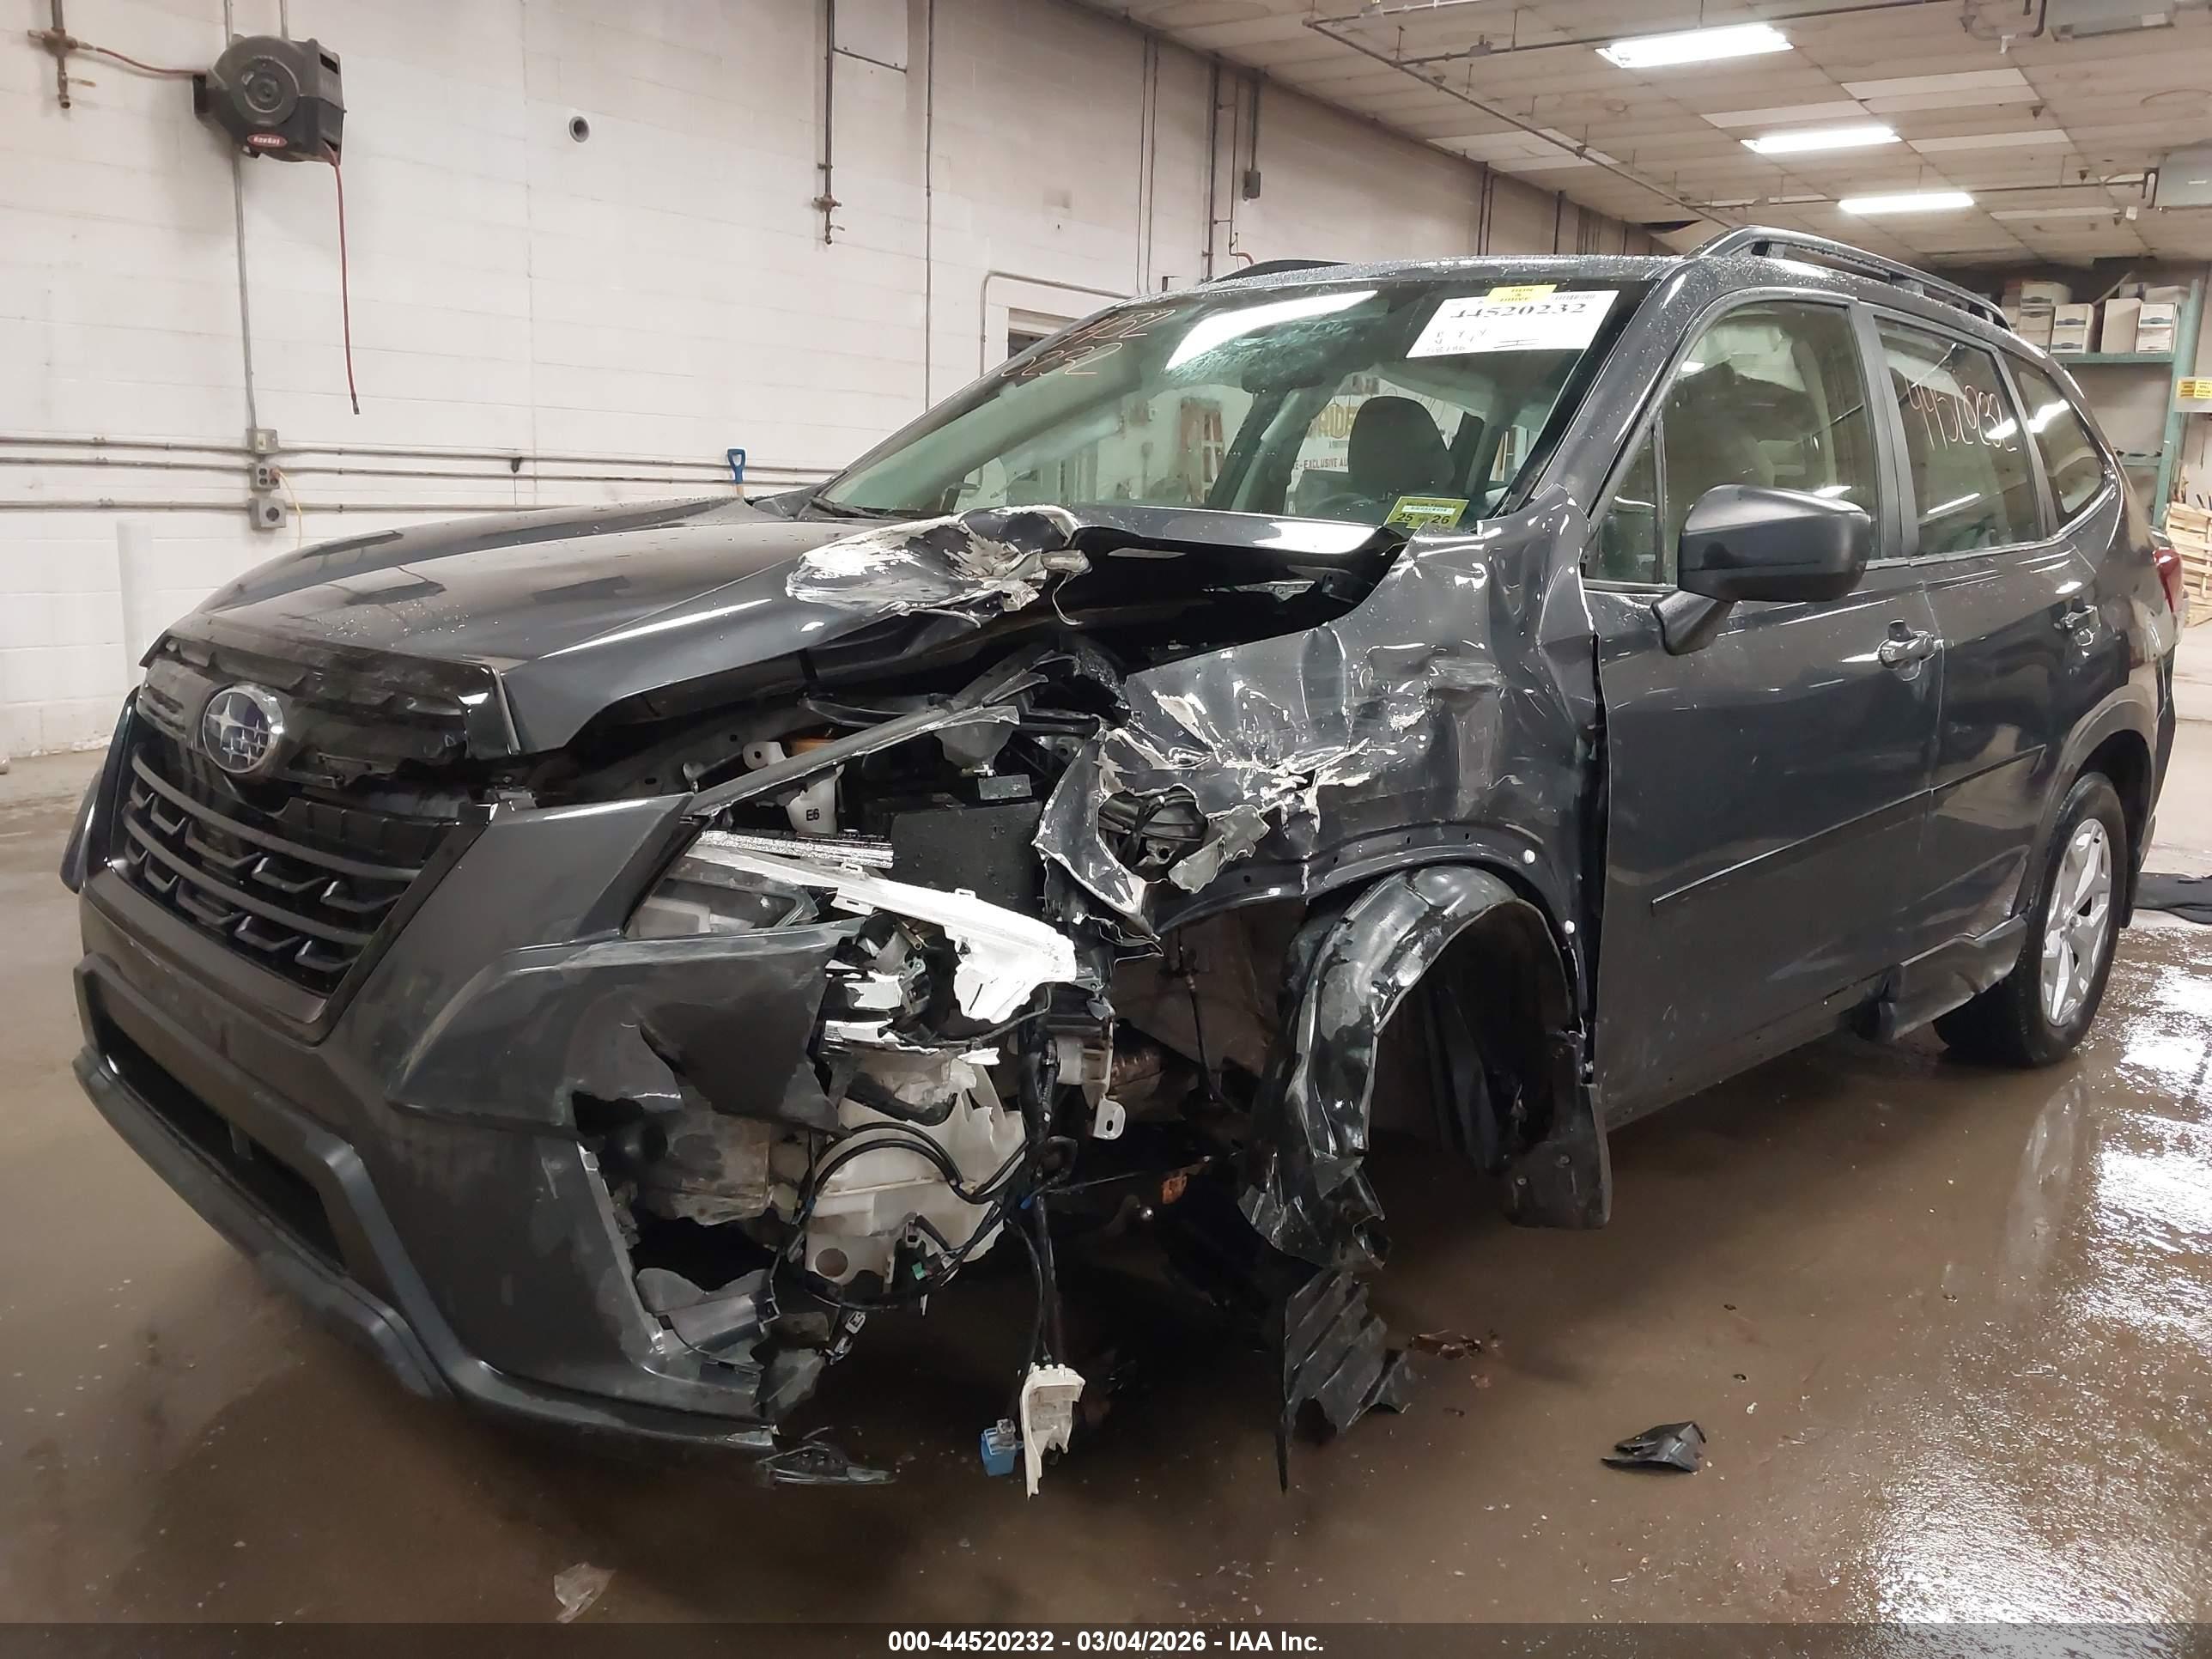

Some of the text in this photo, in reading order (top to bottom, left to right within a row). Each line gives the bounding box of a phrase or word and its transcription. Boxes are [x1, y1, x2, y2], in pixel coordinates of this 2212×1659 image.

[1396, 513, 1415, 522] 25
[1431, 515, 1451, 524] 26
[806, 808, 820, 821] E6
